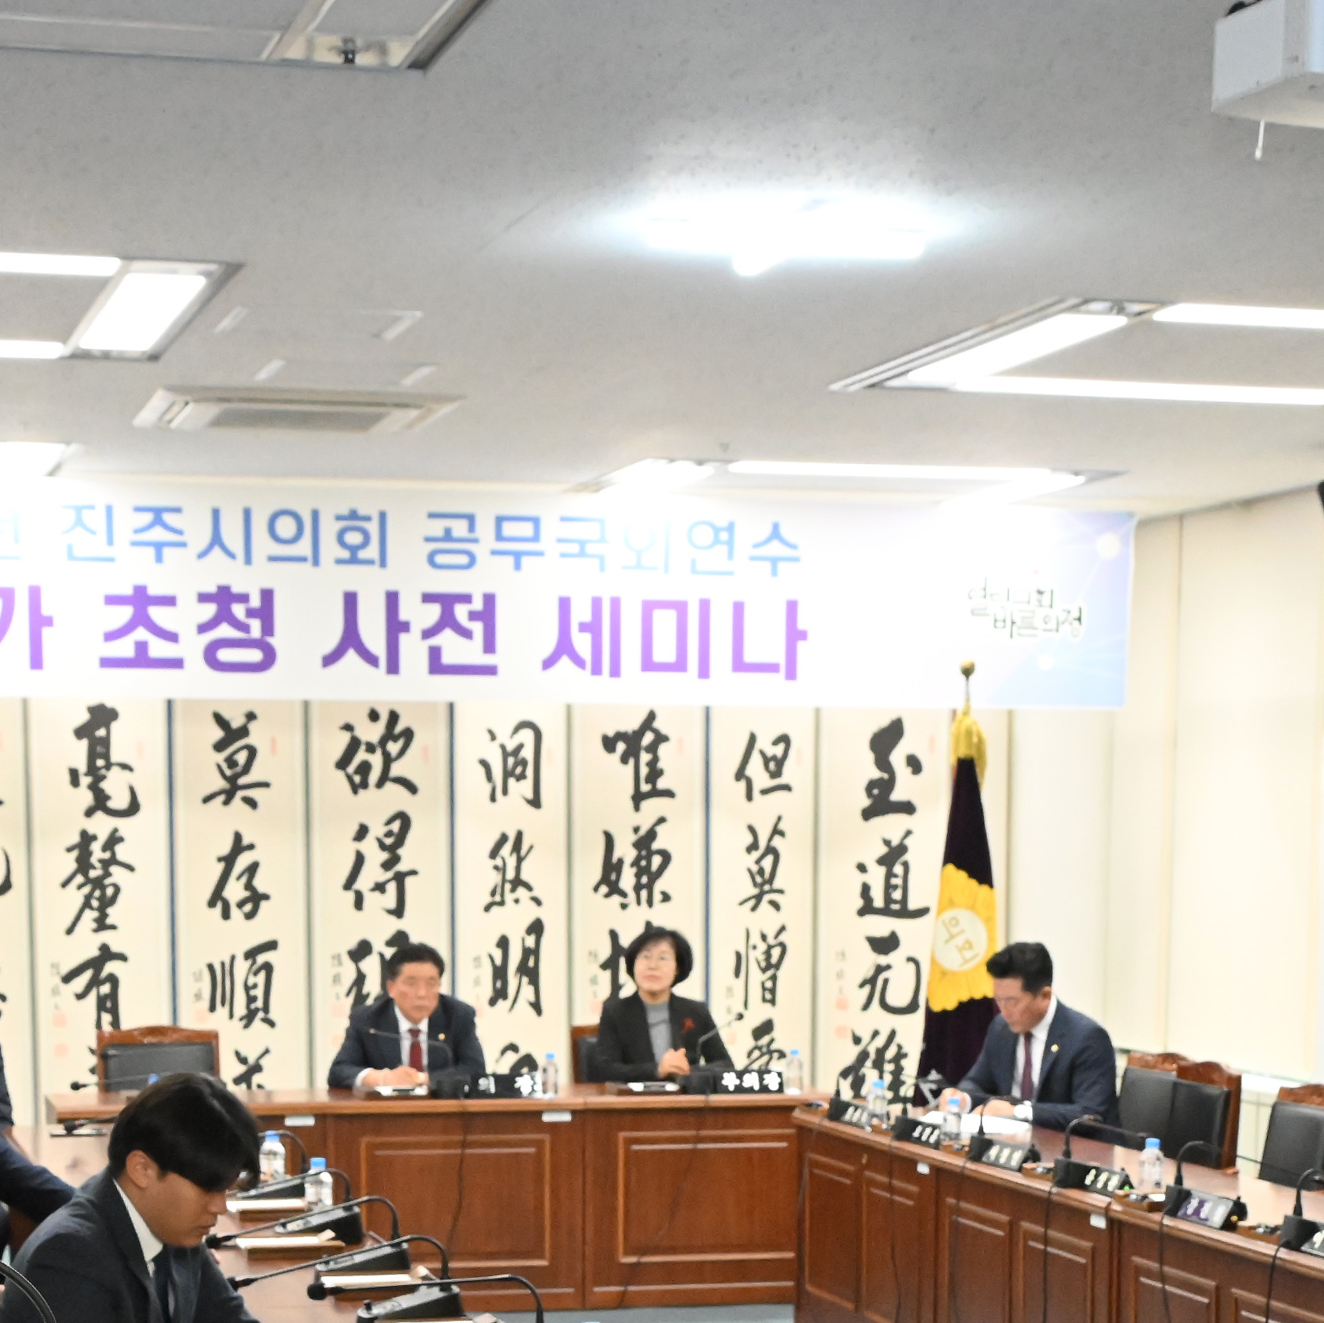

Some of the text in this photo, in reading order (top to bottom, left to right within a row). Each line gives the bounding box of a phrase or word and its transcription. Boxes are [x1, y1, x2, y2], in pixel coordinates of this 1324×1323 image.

[59, 503, 388, 569] 진주시의회
[423, 511, 802, 578] 공무국외연수
[99, 584, 278, 674] 초청
[322, 590, 498, 677] 사전
[542, 596, 808, 681] 세미나
